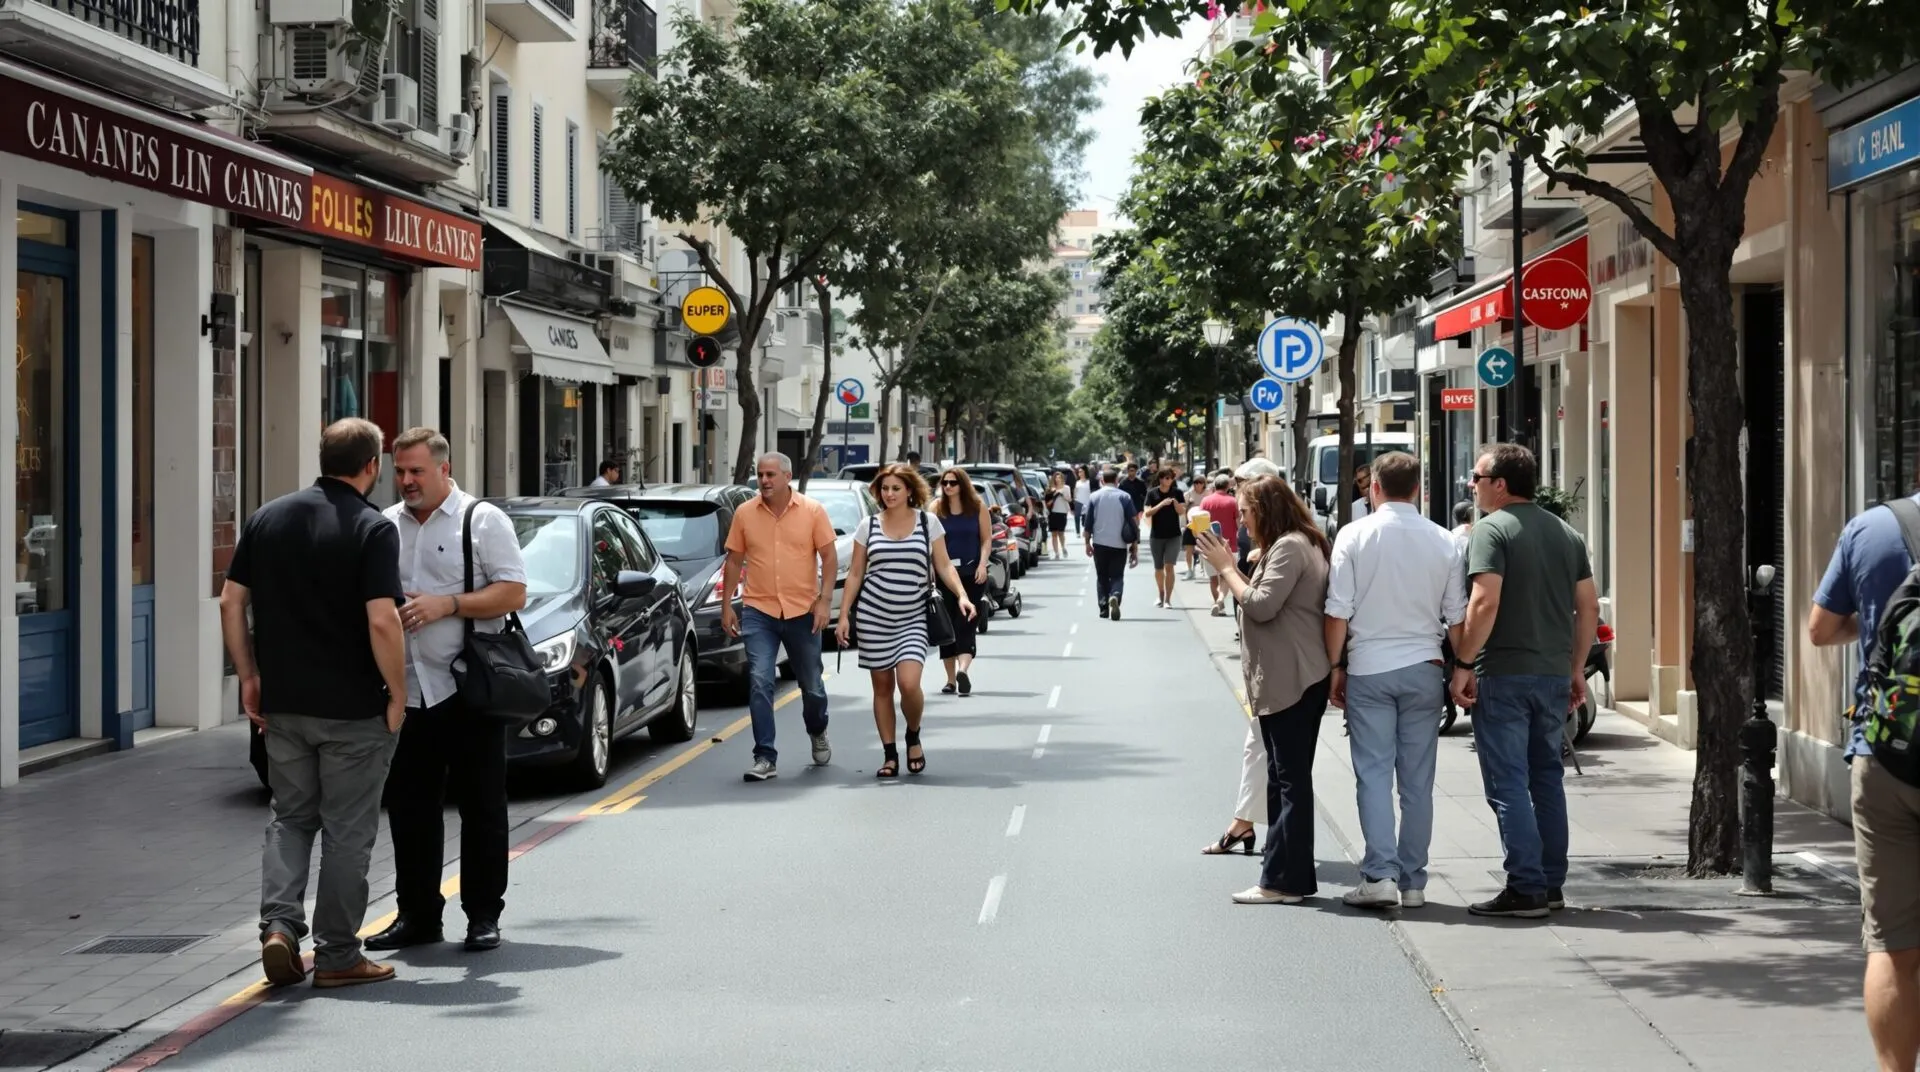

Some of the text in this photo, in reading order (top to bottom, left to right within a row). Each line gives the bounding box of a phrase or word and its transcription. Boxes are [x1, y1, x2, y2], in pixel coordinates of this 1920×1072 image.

[27, 101, 302, 221] CANANES LIN CANNES
[312, 185, 373, 238] FOLLES
[687, 305, 725, 317] EUPER
